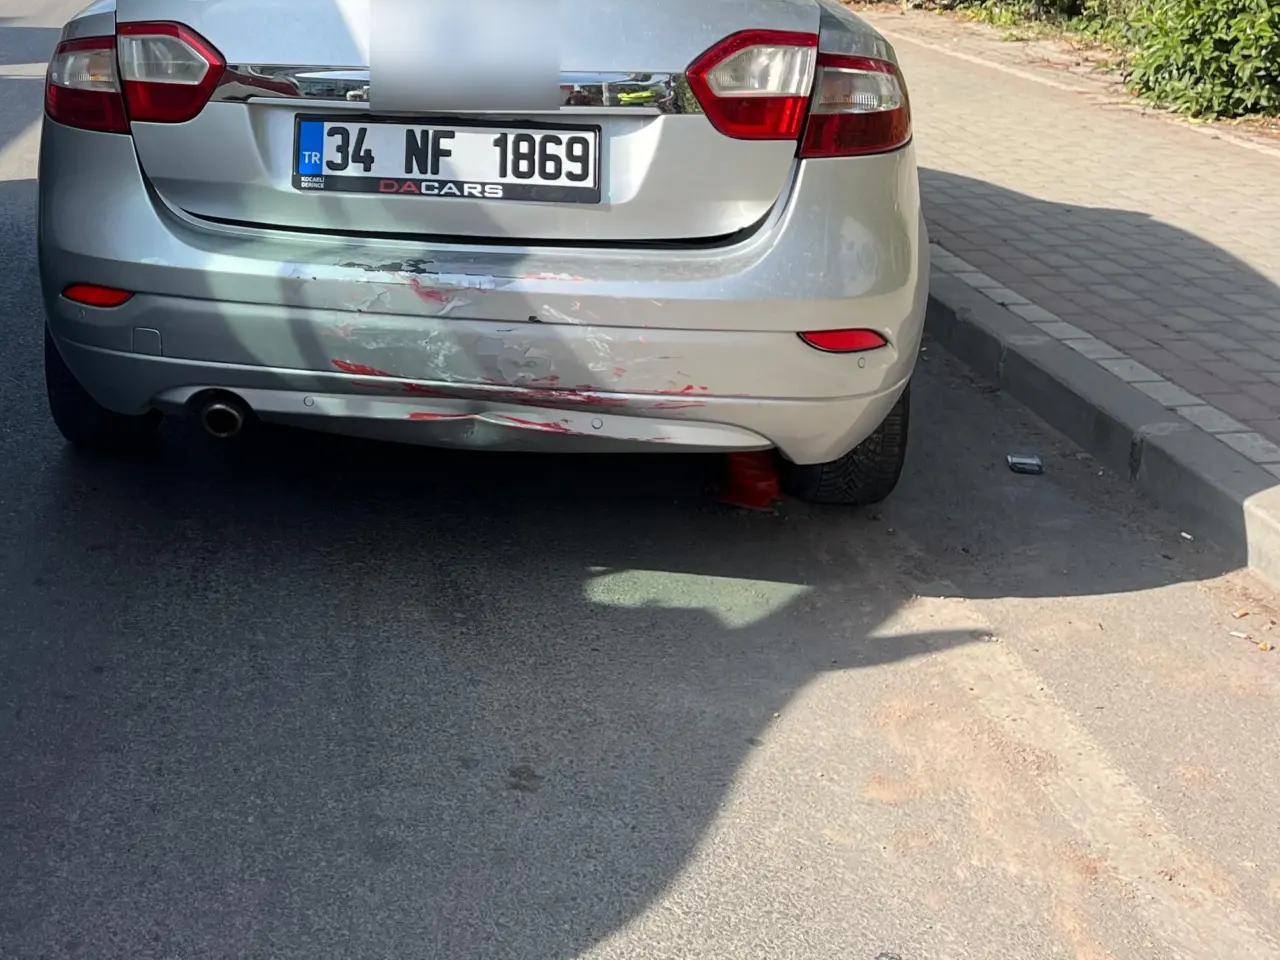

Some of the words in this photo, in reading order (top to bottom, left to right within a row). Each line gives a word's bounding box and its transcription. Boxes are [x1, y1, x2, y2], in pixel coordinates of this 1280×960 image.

[303, 151, 320, 165] TR
[325, 126, 375, 173] 34
[404, 129, 456, 175] NF
[493, 132, 590, 182] 1869
[379, 178, 504, 199] DACARS
